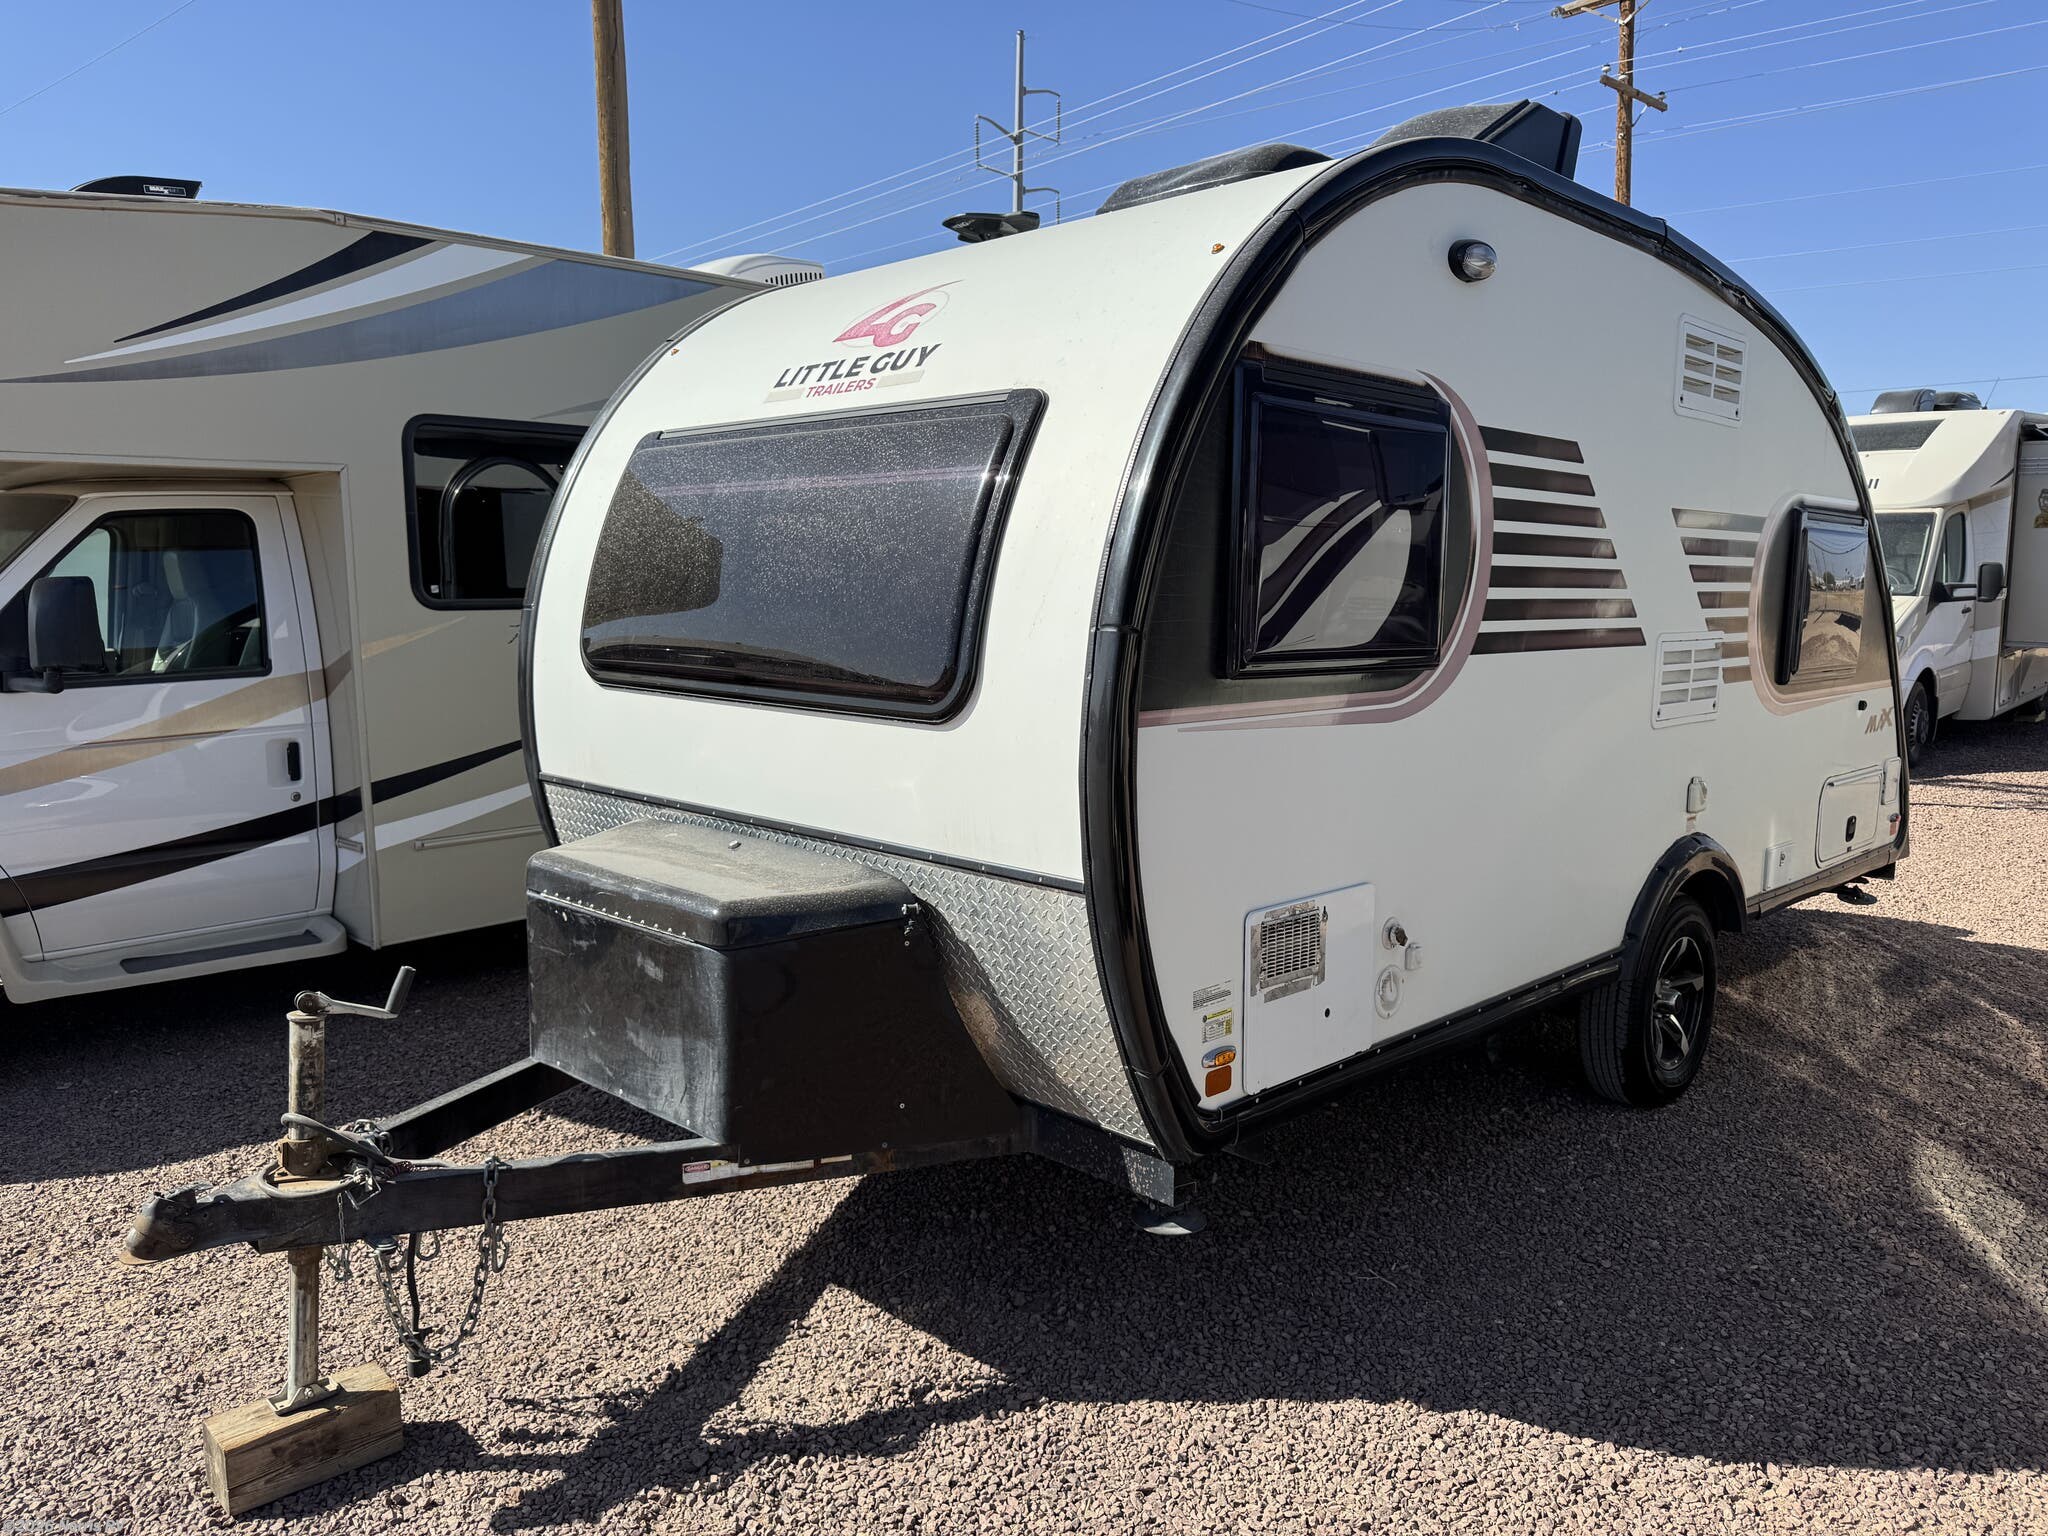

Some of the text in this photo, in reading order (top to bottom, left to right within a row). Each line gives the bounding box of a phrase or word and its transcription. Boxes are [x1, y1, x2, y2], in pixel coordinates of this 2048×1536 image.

[773, 342, 943, 389] LITTLE GUY
[805, 377, 877, 399] TRAILERS
[1864, 706, 1894, 735] MAX
